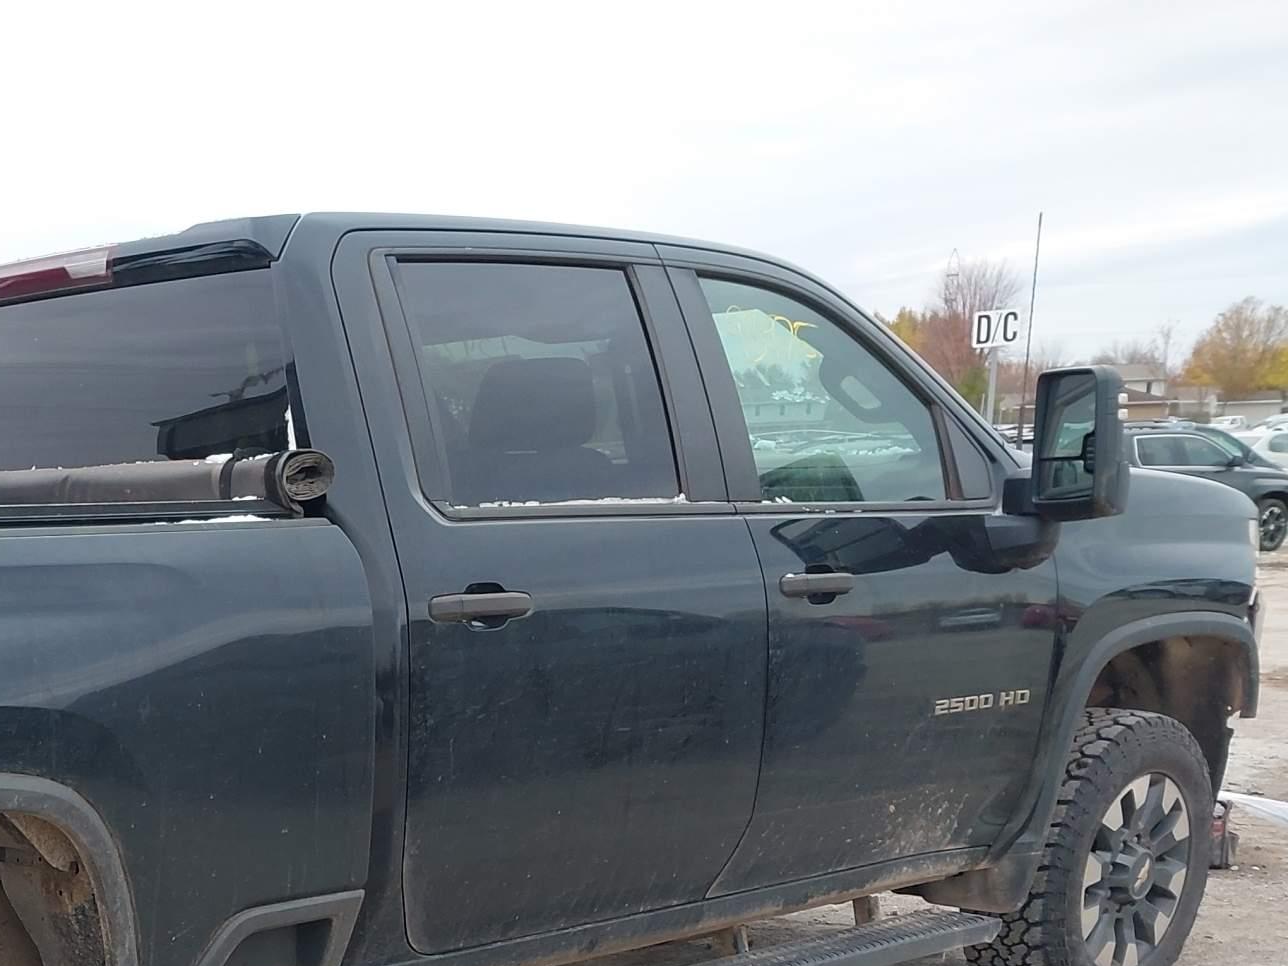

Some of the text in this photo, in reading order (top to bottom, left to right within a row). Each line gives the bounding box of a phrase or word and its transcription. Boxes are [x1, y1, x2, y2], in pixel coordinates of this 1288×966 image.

[976, 311, 1018, 345] D/C
[934, 689, 1030, 715] 2500 HD
